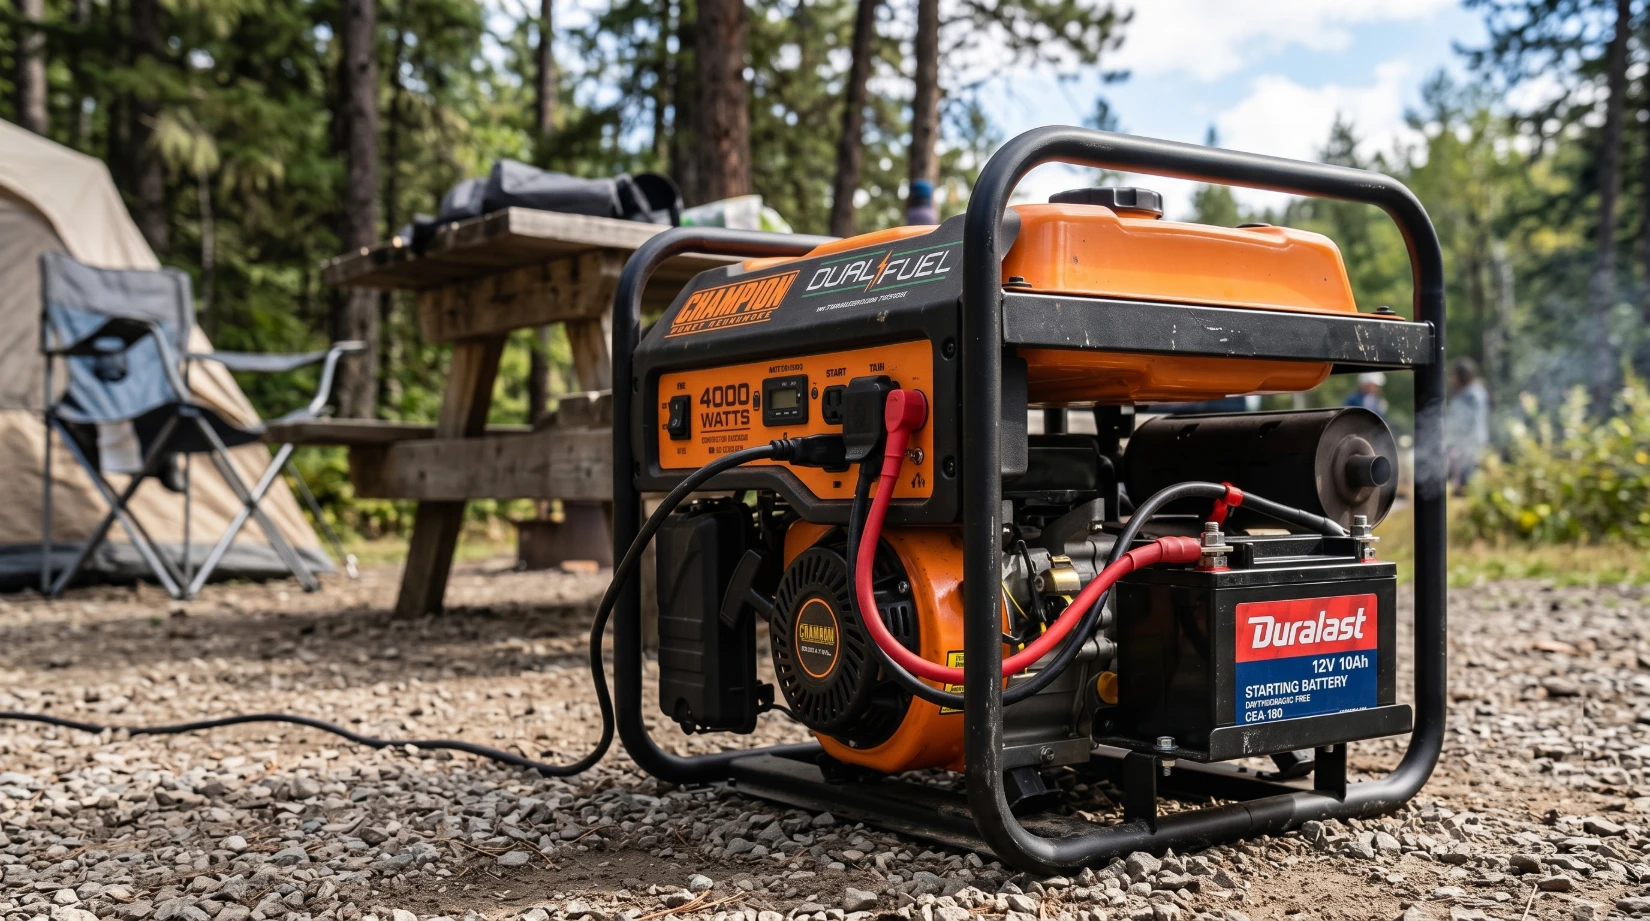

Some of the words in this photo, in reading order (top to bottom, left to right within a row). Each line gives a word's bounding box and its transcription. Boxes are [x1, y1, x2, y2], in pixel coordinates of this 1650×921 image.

[806, 258, 874, 291] DUAL
[877, 250, 951, 285] FUEL
[675, 273, 797, 325] CHAMPION
[826, 367, 846, 378] START
[700, 383, 750, 408] 4000
[701, 409, 750, 428] WATTS
[1248, 608, 1367, 649] Duralast
[1312, 658, 1336, 673] 12V
[1339, 655, 1369, 671] 10Ah
[1245, 681, 1299, 698] STARTING
[1302, 675, 1349, 691] BATTERY
[1295, 694, 1311, 703] FREE
